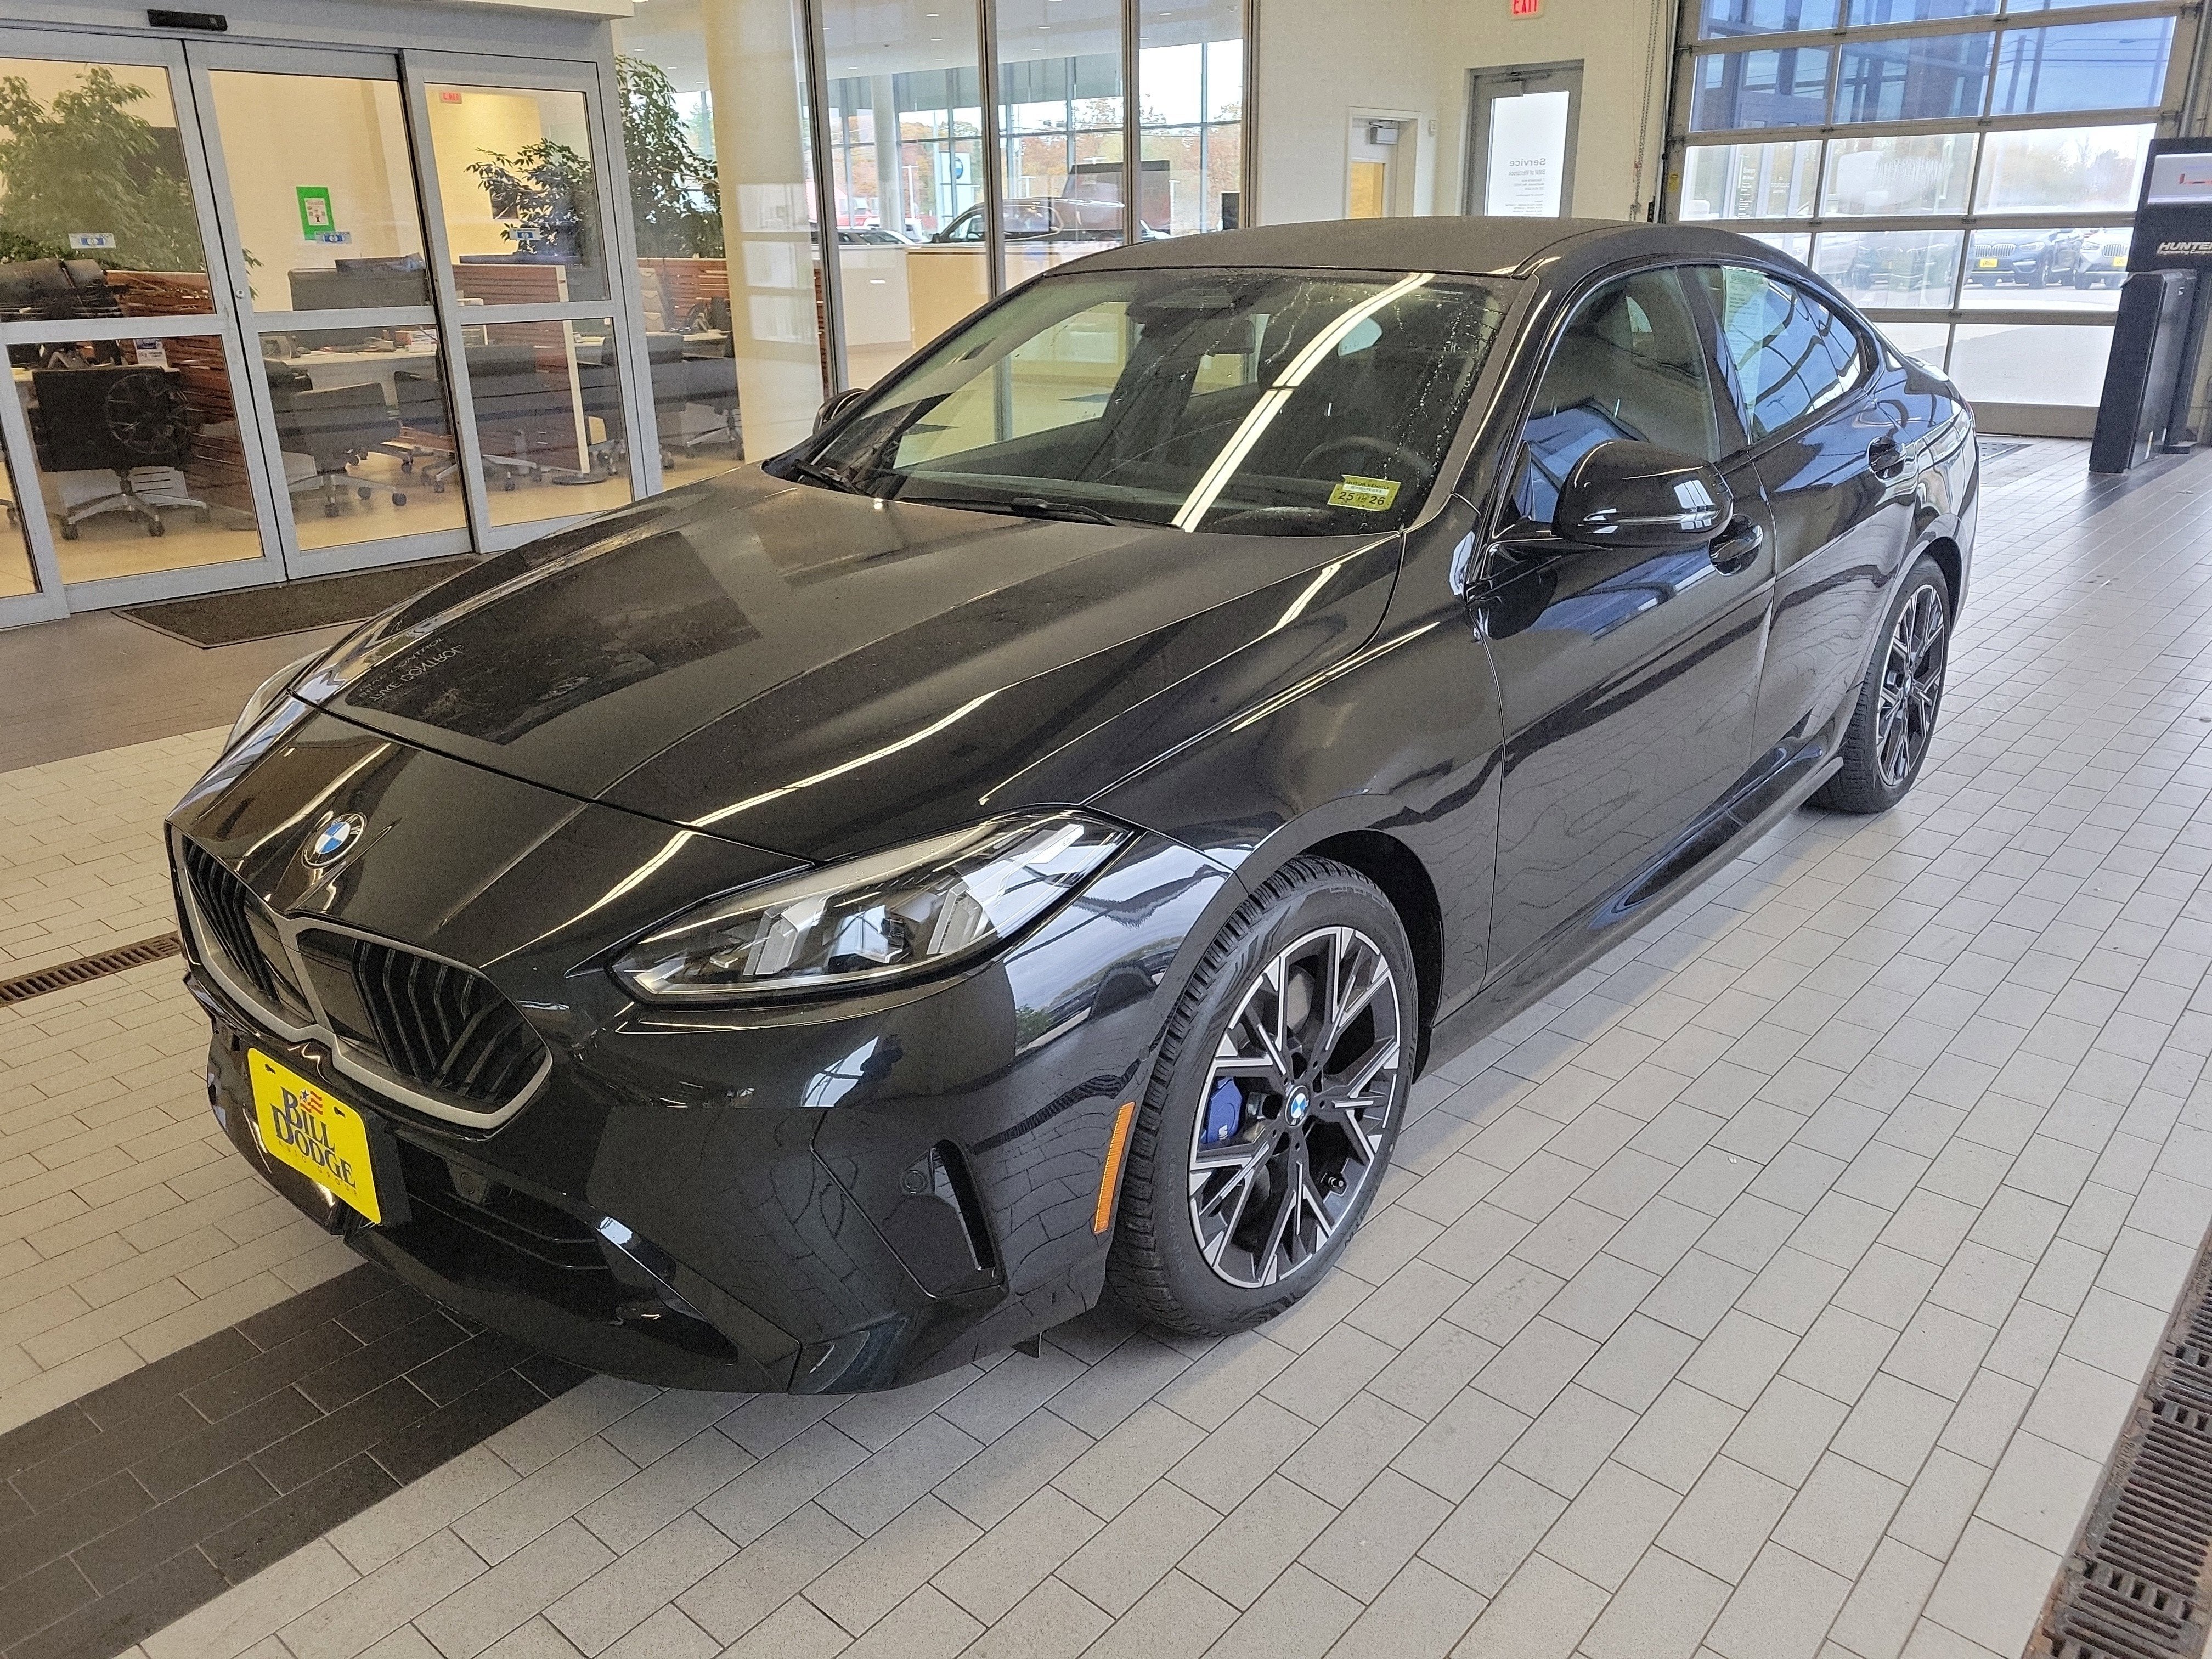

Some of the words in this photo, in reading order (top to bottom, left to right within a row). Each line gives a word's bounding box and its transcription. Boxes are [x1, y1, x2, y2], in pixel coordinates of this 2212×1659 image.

[2159, 242, 2212, 250] HUNTE
[1338, 491, 1356, 501] 25
[1368, 495, 1386, 505] 26
[270, 1103, 357, 1189] DODGE
[280, 1086, 336, 1152] BILL
[279, 1141, 307, 1164] AUTO
[318, 1165, 357, 1196] GROUP
